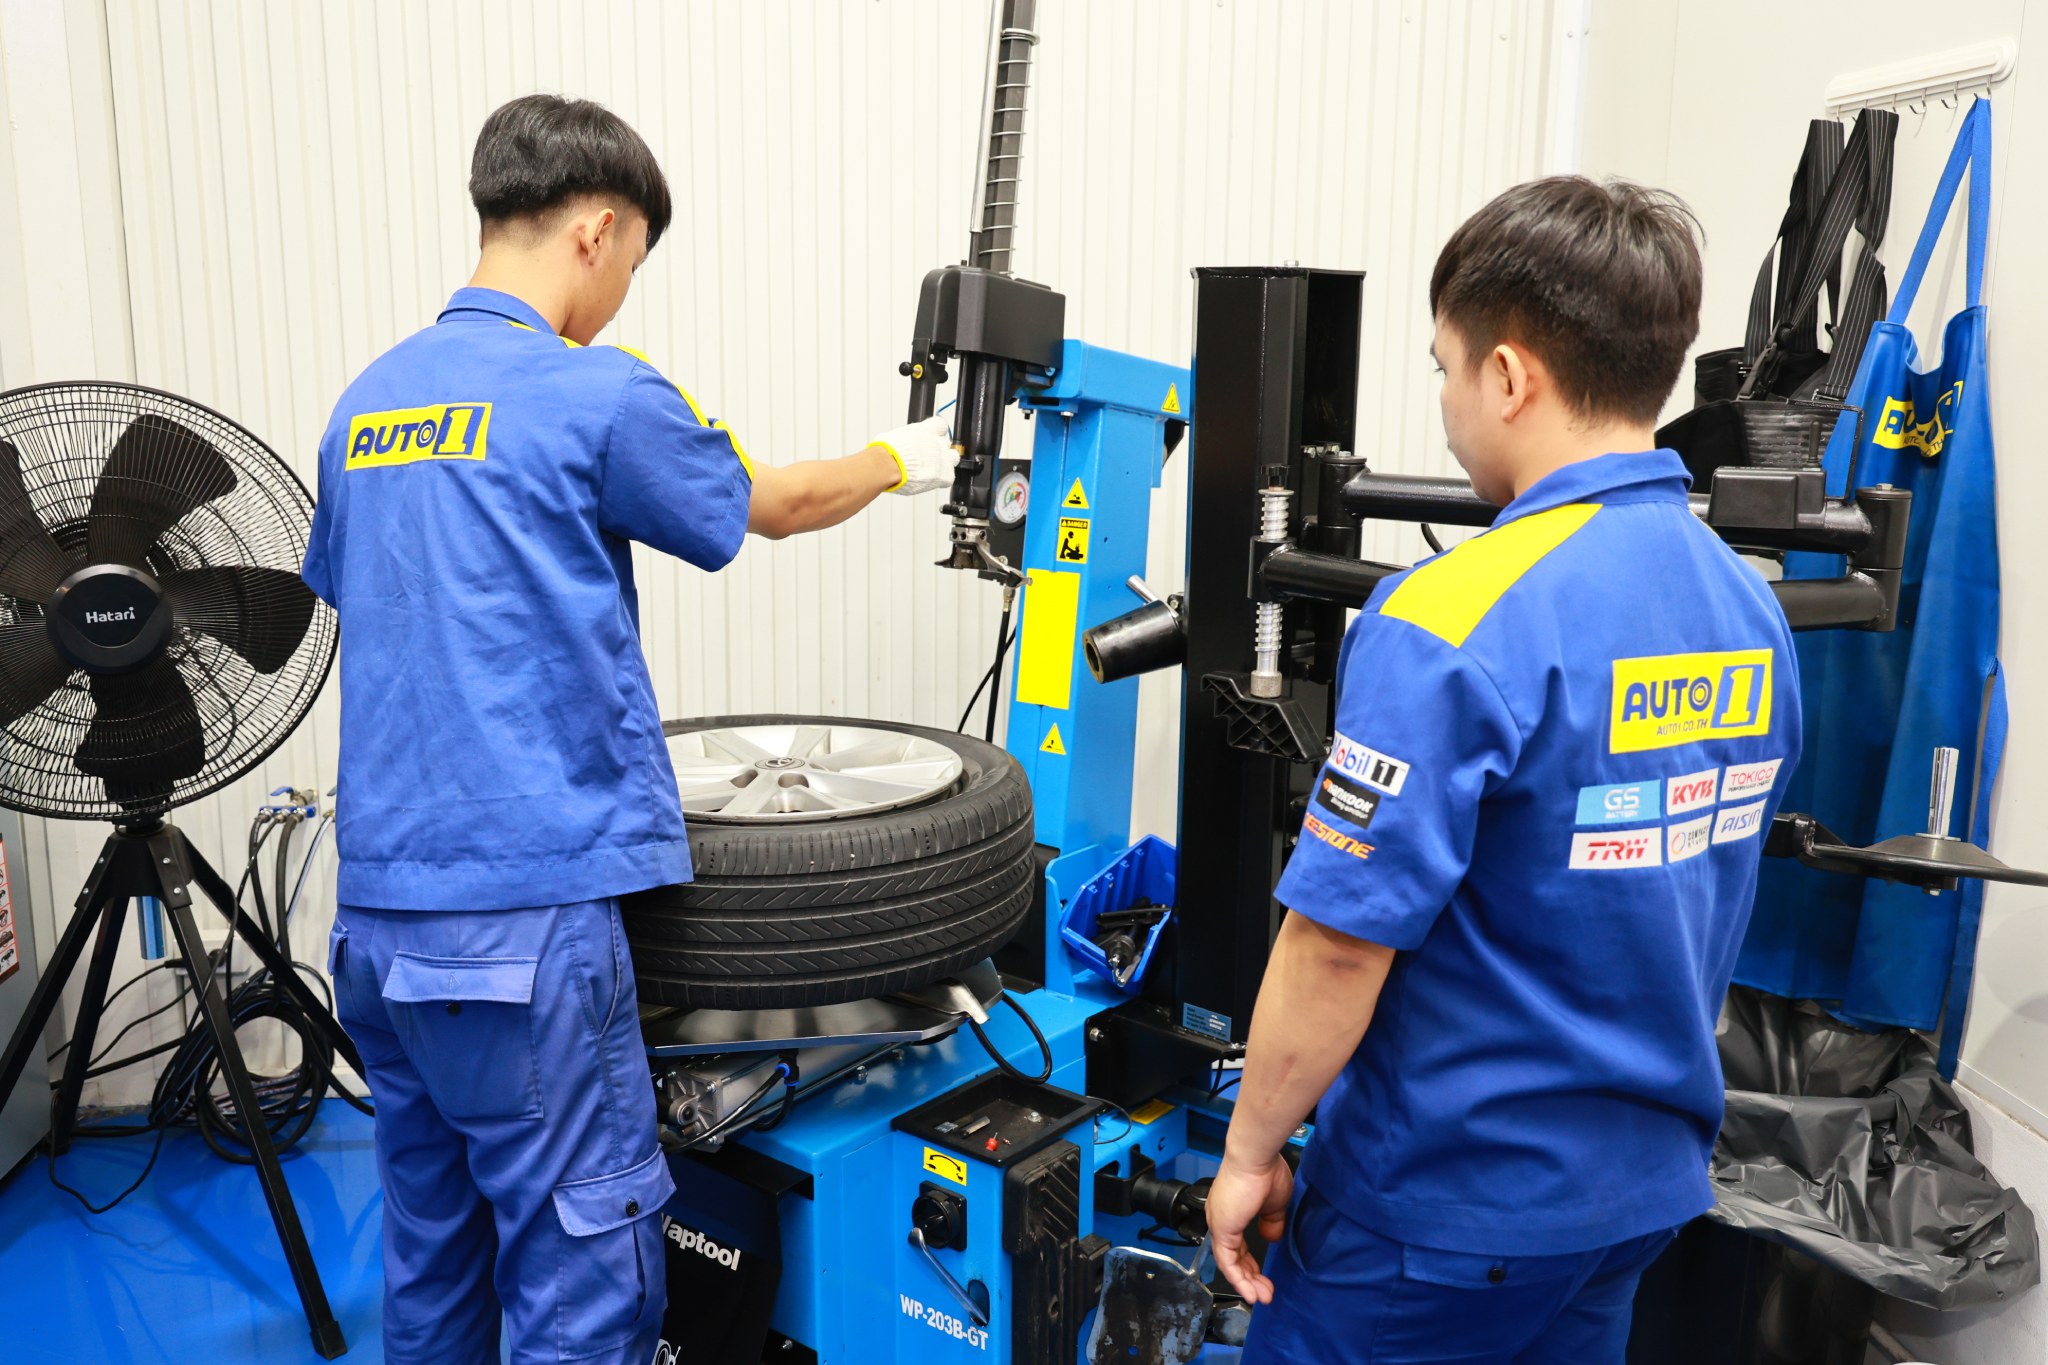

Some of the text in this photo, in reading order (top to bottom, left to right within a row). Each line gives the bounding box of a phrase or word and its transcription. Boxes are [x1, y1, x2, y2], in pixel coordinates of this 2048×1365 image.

[85, 606, 136, 624] Hatari
[1656, 718, 1708, 735] AUTO1.CO.TH
[1731, 767, 1774, 786] TOKICO
[1604, 787, 1640, 811] GS
[1672, 779, 1714, 806] KYB
[1721, 808, 1761, 833] AISIN
[1587, 838, 1649, 861] TRW
[900, 1293, 989, 1351] WP-203B-GT
